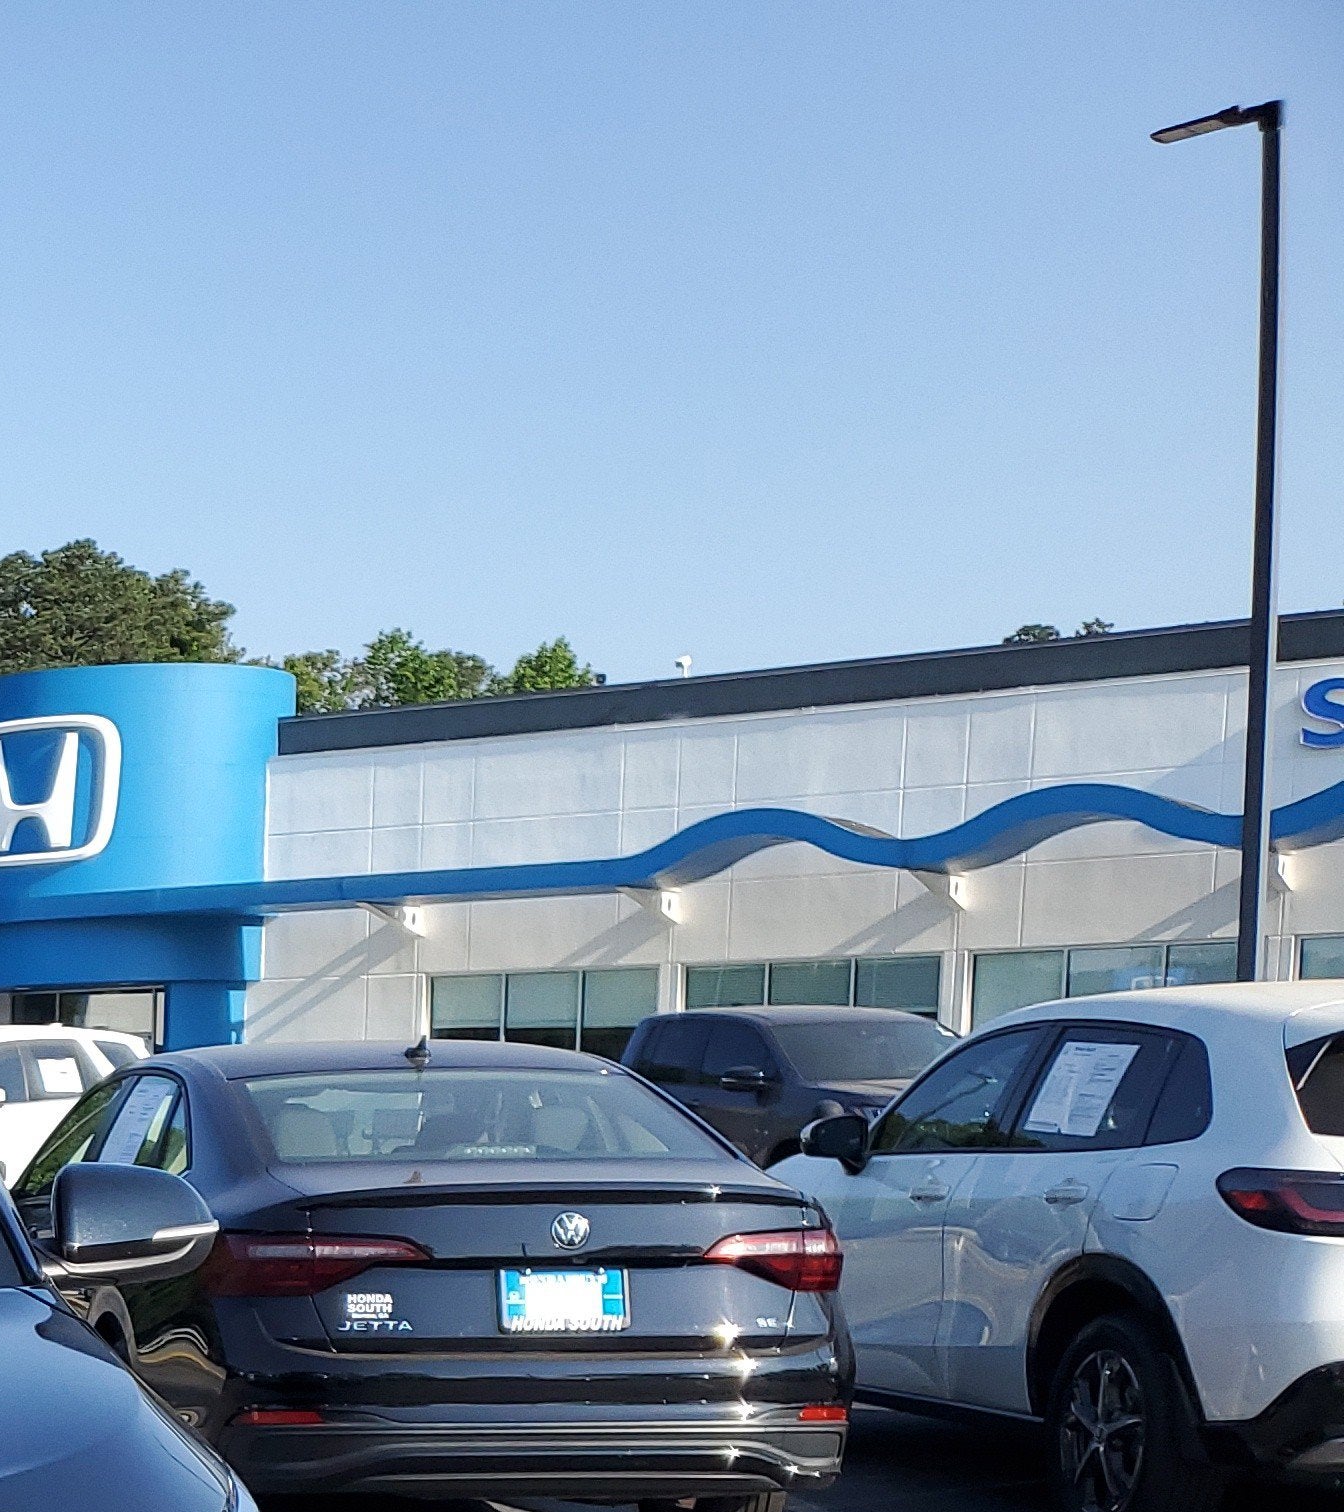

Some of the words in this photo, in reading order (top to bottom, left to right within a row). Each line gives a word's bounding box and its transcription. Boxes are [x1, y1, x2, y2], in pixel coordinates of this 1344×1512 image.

[346, 1293, 393, 1304] HONDA
[347, 1303, 393, 1313] SOUTH
[337, 1320, 413, 1331] JETTA
[511, 1315, 566, 1331] HONDA
[567, 1315, 625, 1331] SOUTH
